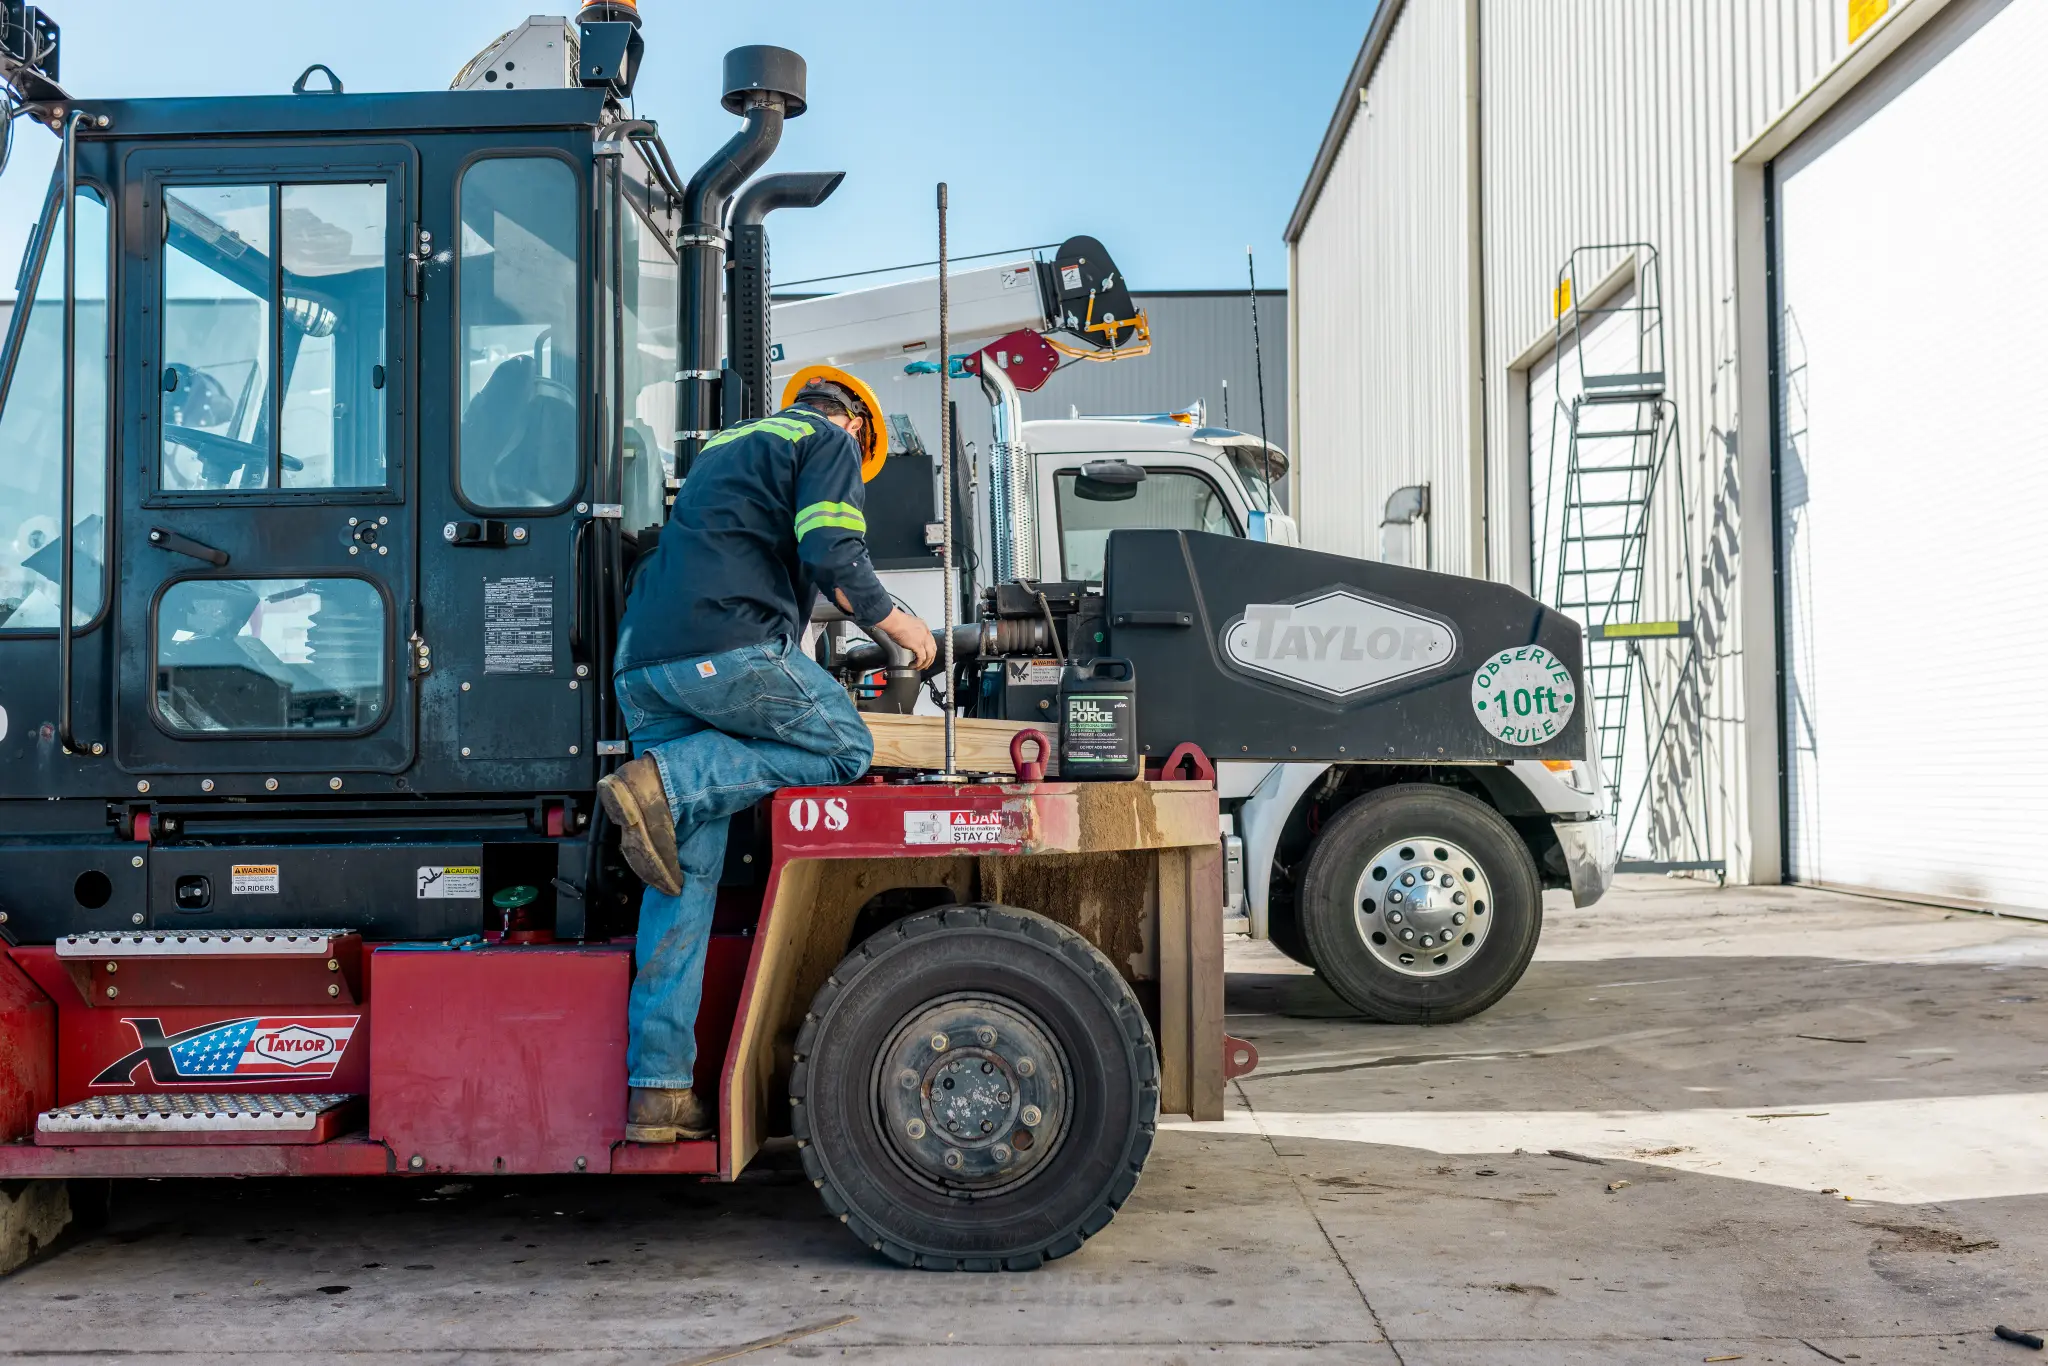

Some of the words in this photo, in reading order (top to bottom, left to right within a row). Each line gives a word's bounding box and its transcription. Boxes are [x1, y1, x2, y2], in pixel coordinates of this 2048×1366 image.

[1248, 606, 1436, 661] TAYLOR
[1477, 648, 1570, 689] OBSERVE
[1069, 700, 1100, 712] FULL
[1493, 686, 1559, 718] 10ft
[1069, 711, 1113, 722] FORCE
[1499, 719, 1556, 743] RULE
[789, 797, 849, 832] 08
[969, 812, 1002, 825] DAN
[953, 832, 982, 842] STAY
[450, 867, 480, 875] CAUTION
[264, 1033, 326, 1053] TAYLOR
